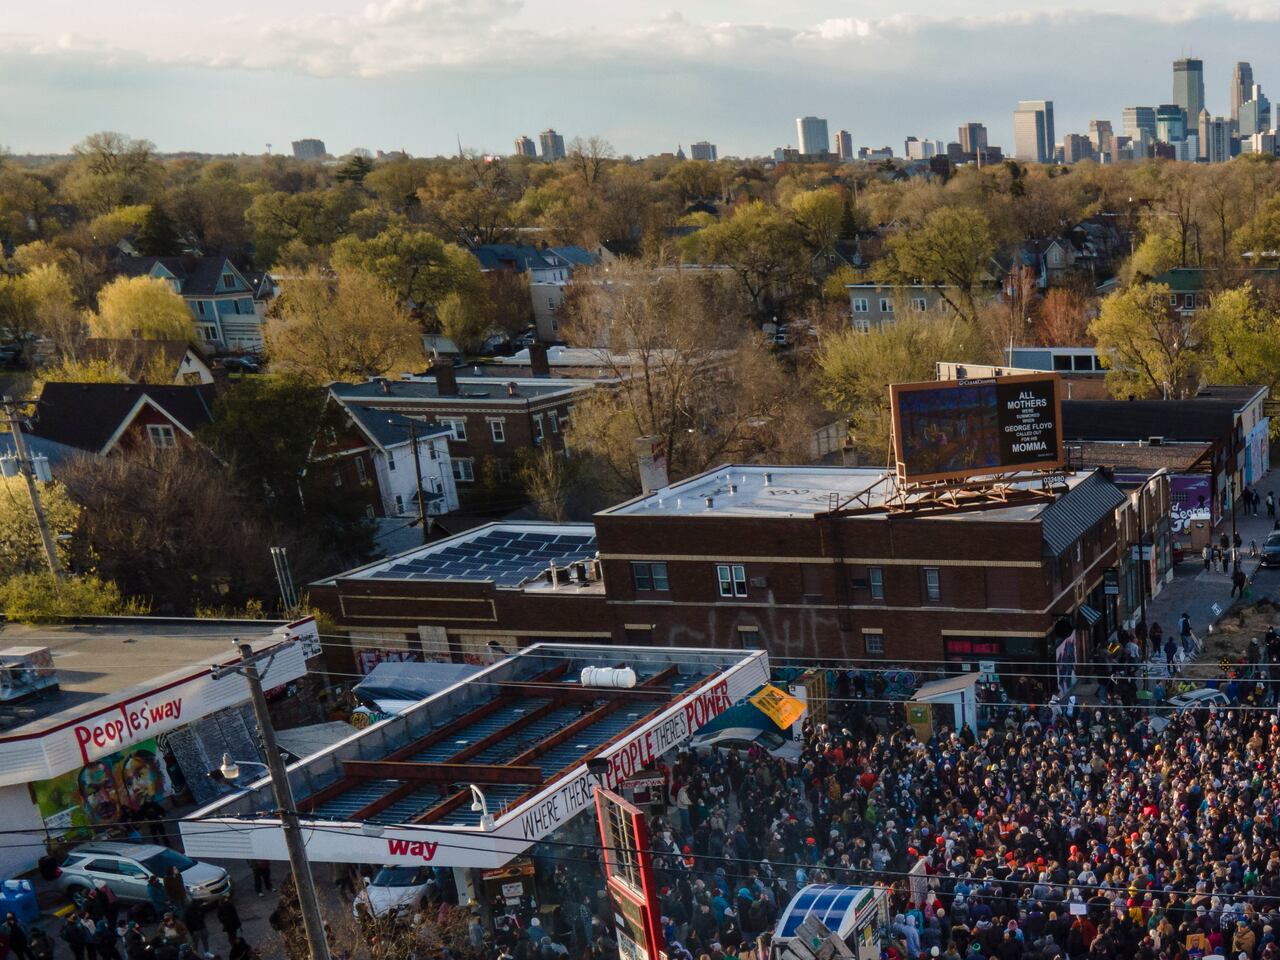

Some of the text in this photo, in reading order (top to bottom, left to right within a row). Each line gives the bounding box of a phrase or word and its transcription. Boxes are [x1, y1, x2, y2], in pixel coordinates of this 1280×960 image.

[1019, 391, 1035, 400] ALL
[1007, 399, 1047, 410] MOTHERS
[1005, 422, 1053, 433] GEORGE FLOYD
[1012, 441, 1047, 453] MOMMA
[522, 796, 560, 839] WHERE
[606, 731, 655, 789] PEOPLE
[685, 679, 733, 735] POWER
[388, 839, 438, 861] way
